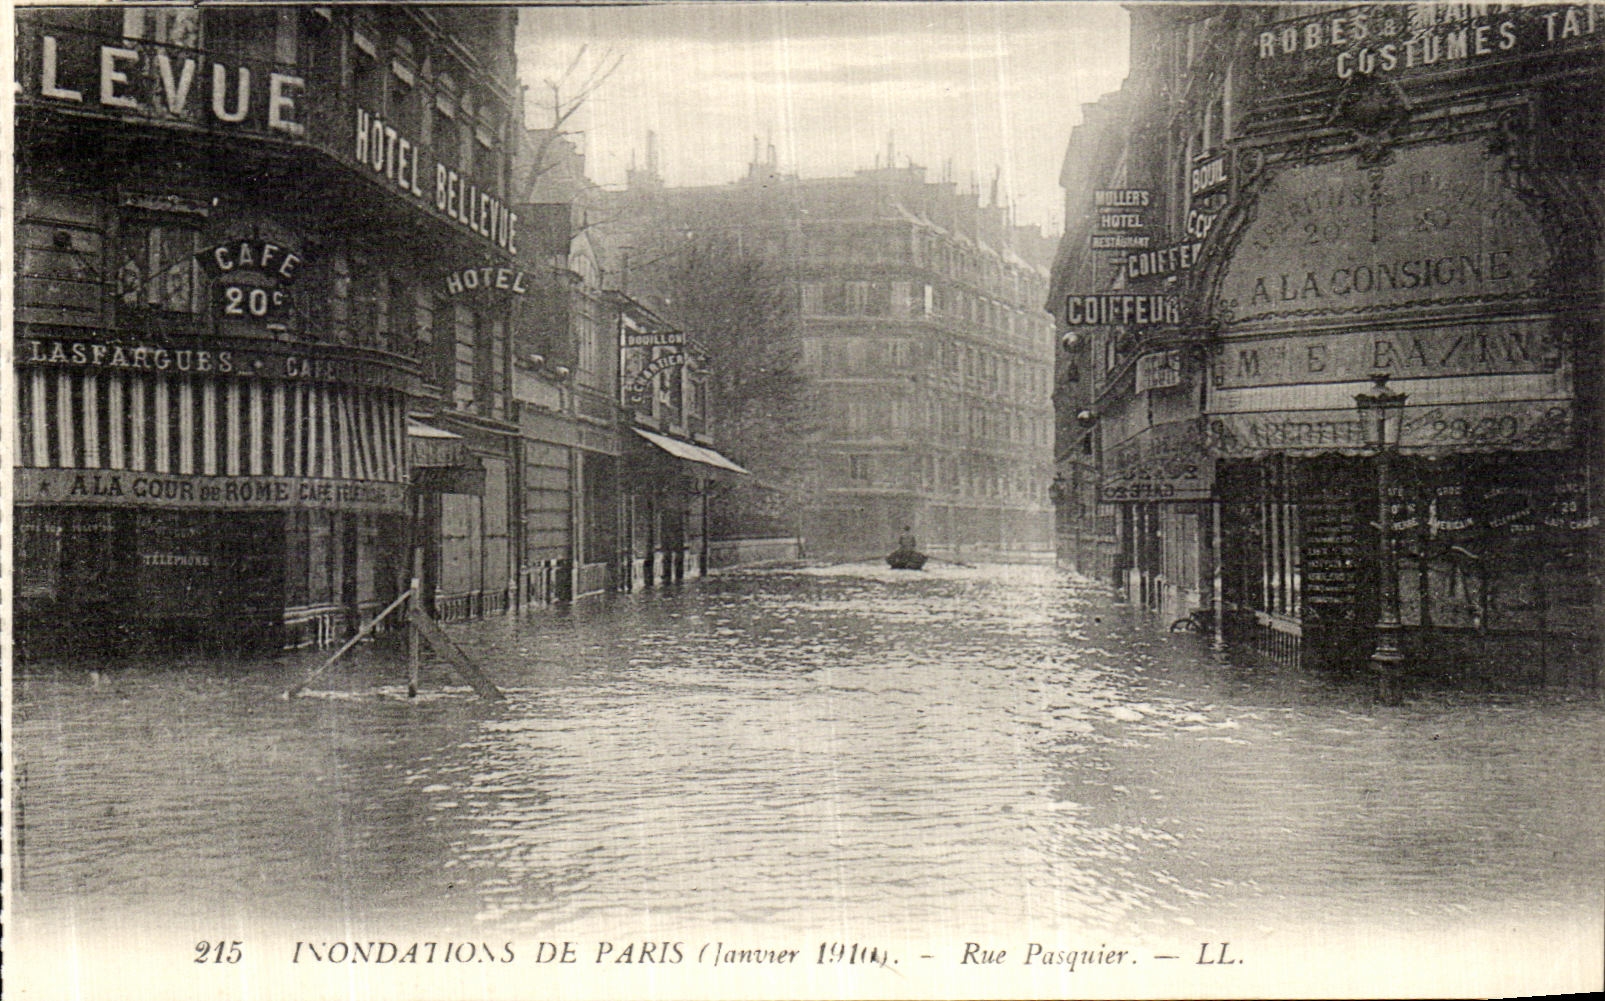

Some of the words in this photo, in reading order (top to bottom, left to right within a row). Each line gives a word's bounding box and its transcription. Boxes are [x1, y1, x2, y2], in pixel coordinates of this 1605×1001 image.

[1259, 14, 1369, 58] ROBES
[1336, 21, 1517, 79] COSTUMES
[14, 34, 305, 135] LEVUE
[436, 162, 518, 255] BELLEVUE
[446, 267, 526, 295] HOTEL
[1251, 275, 1271, 305] A
[1280, 271, 1321, 301] LA
[1329, 250, 1513, 297] CONSIGNE
[1067, 294, 1181, 325] COIFFEUR
[1373, 331, 1532, 371] BAZIN
[70, 474, 88, 496] A
[93, 476, 125, 497] LA
[132, 478, 195, 500] COUR
[225, 480, 290, 502] ROME
